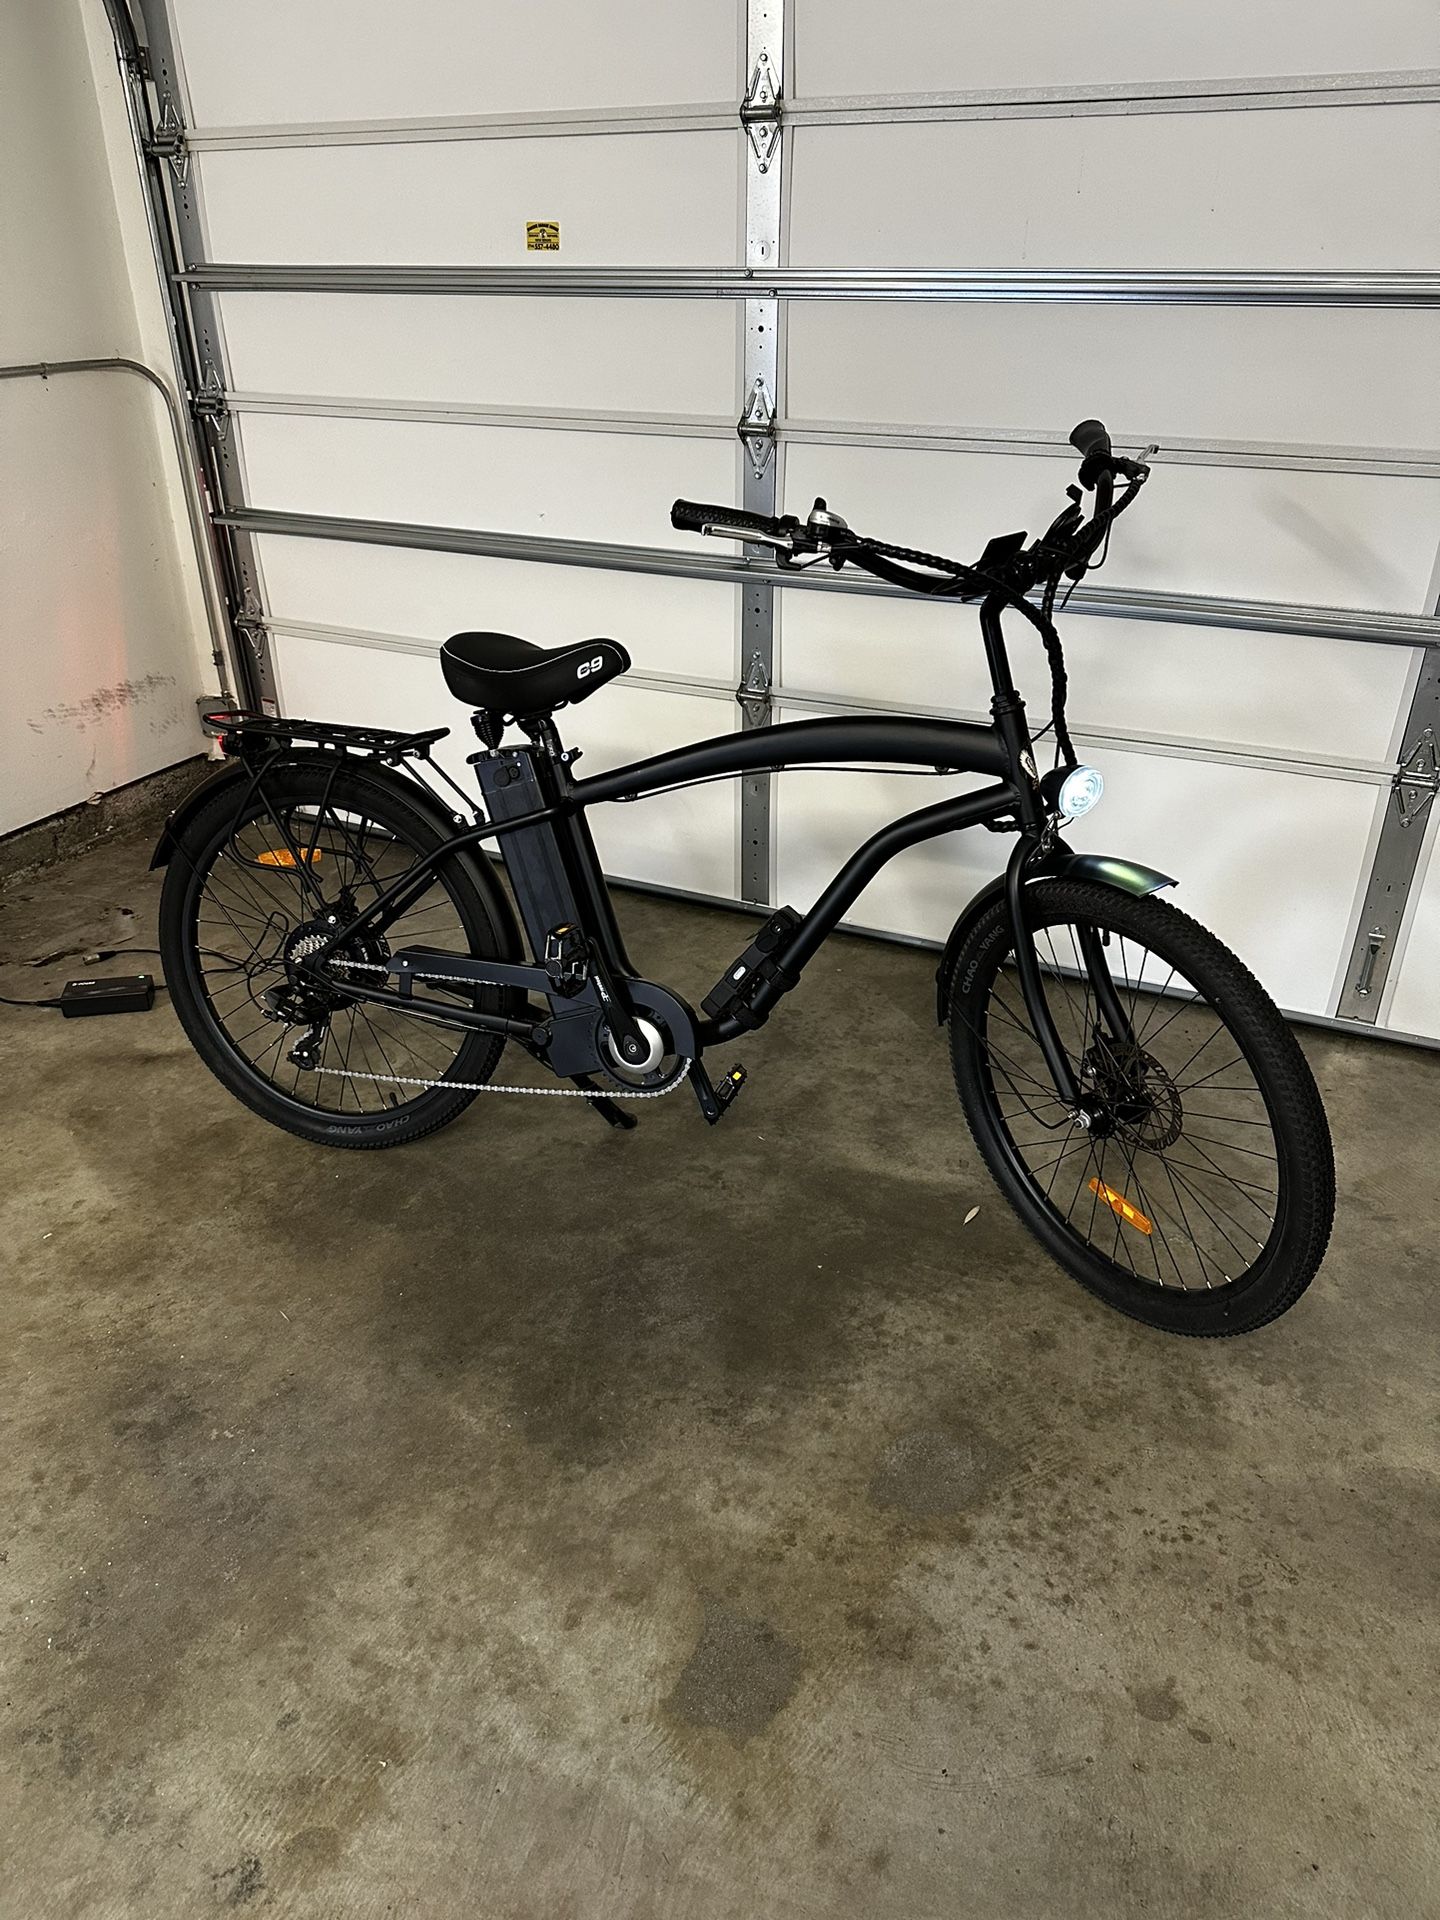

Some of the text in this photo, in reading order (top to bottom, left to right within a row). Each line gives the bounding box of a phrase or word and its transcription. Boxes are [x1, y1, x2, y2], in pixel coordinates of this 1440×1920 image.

[962, 925, 1005, 994] CHAO YANG
[327, 1115, 411, 1135] CHAO YANG
